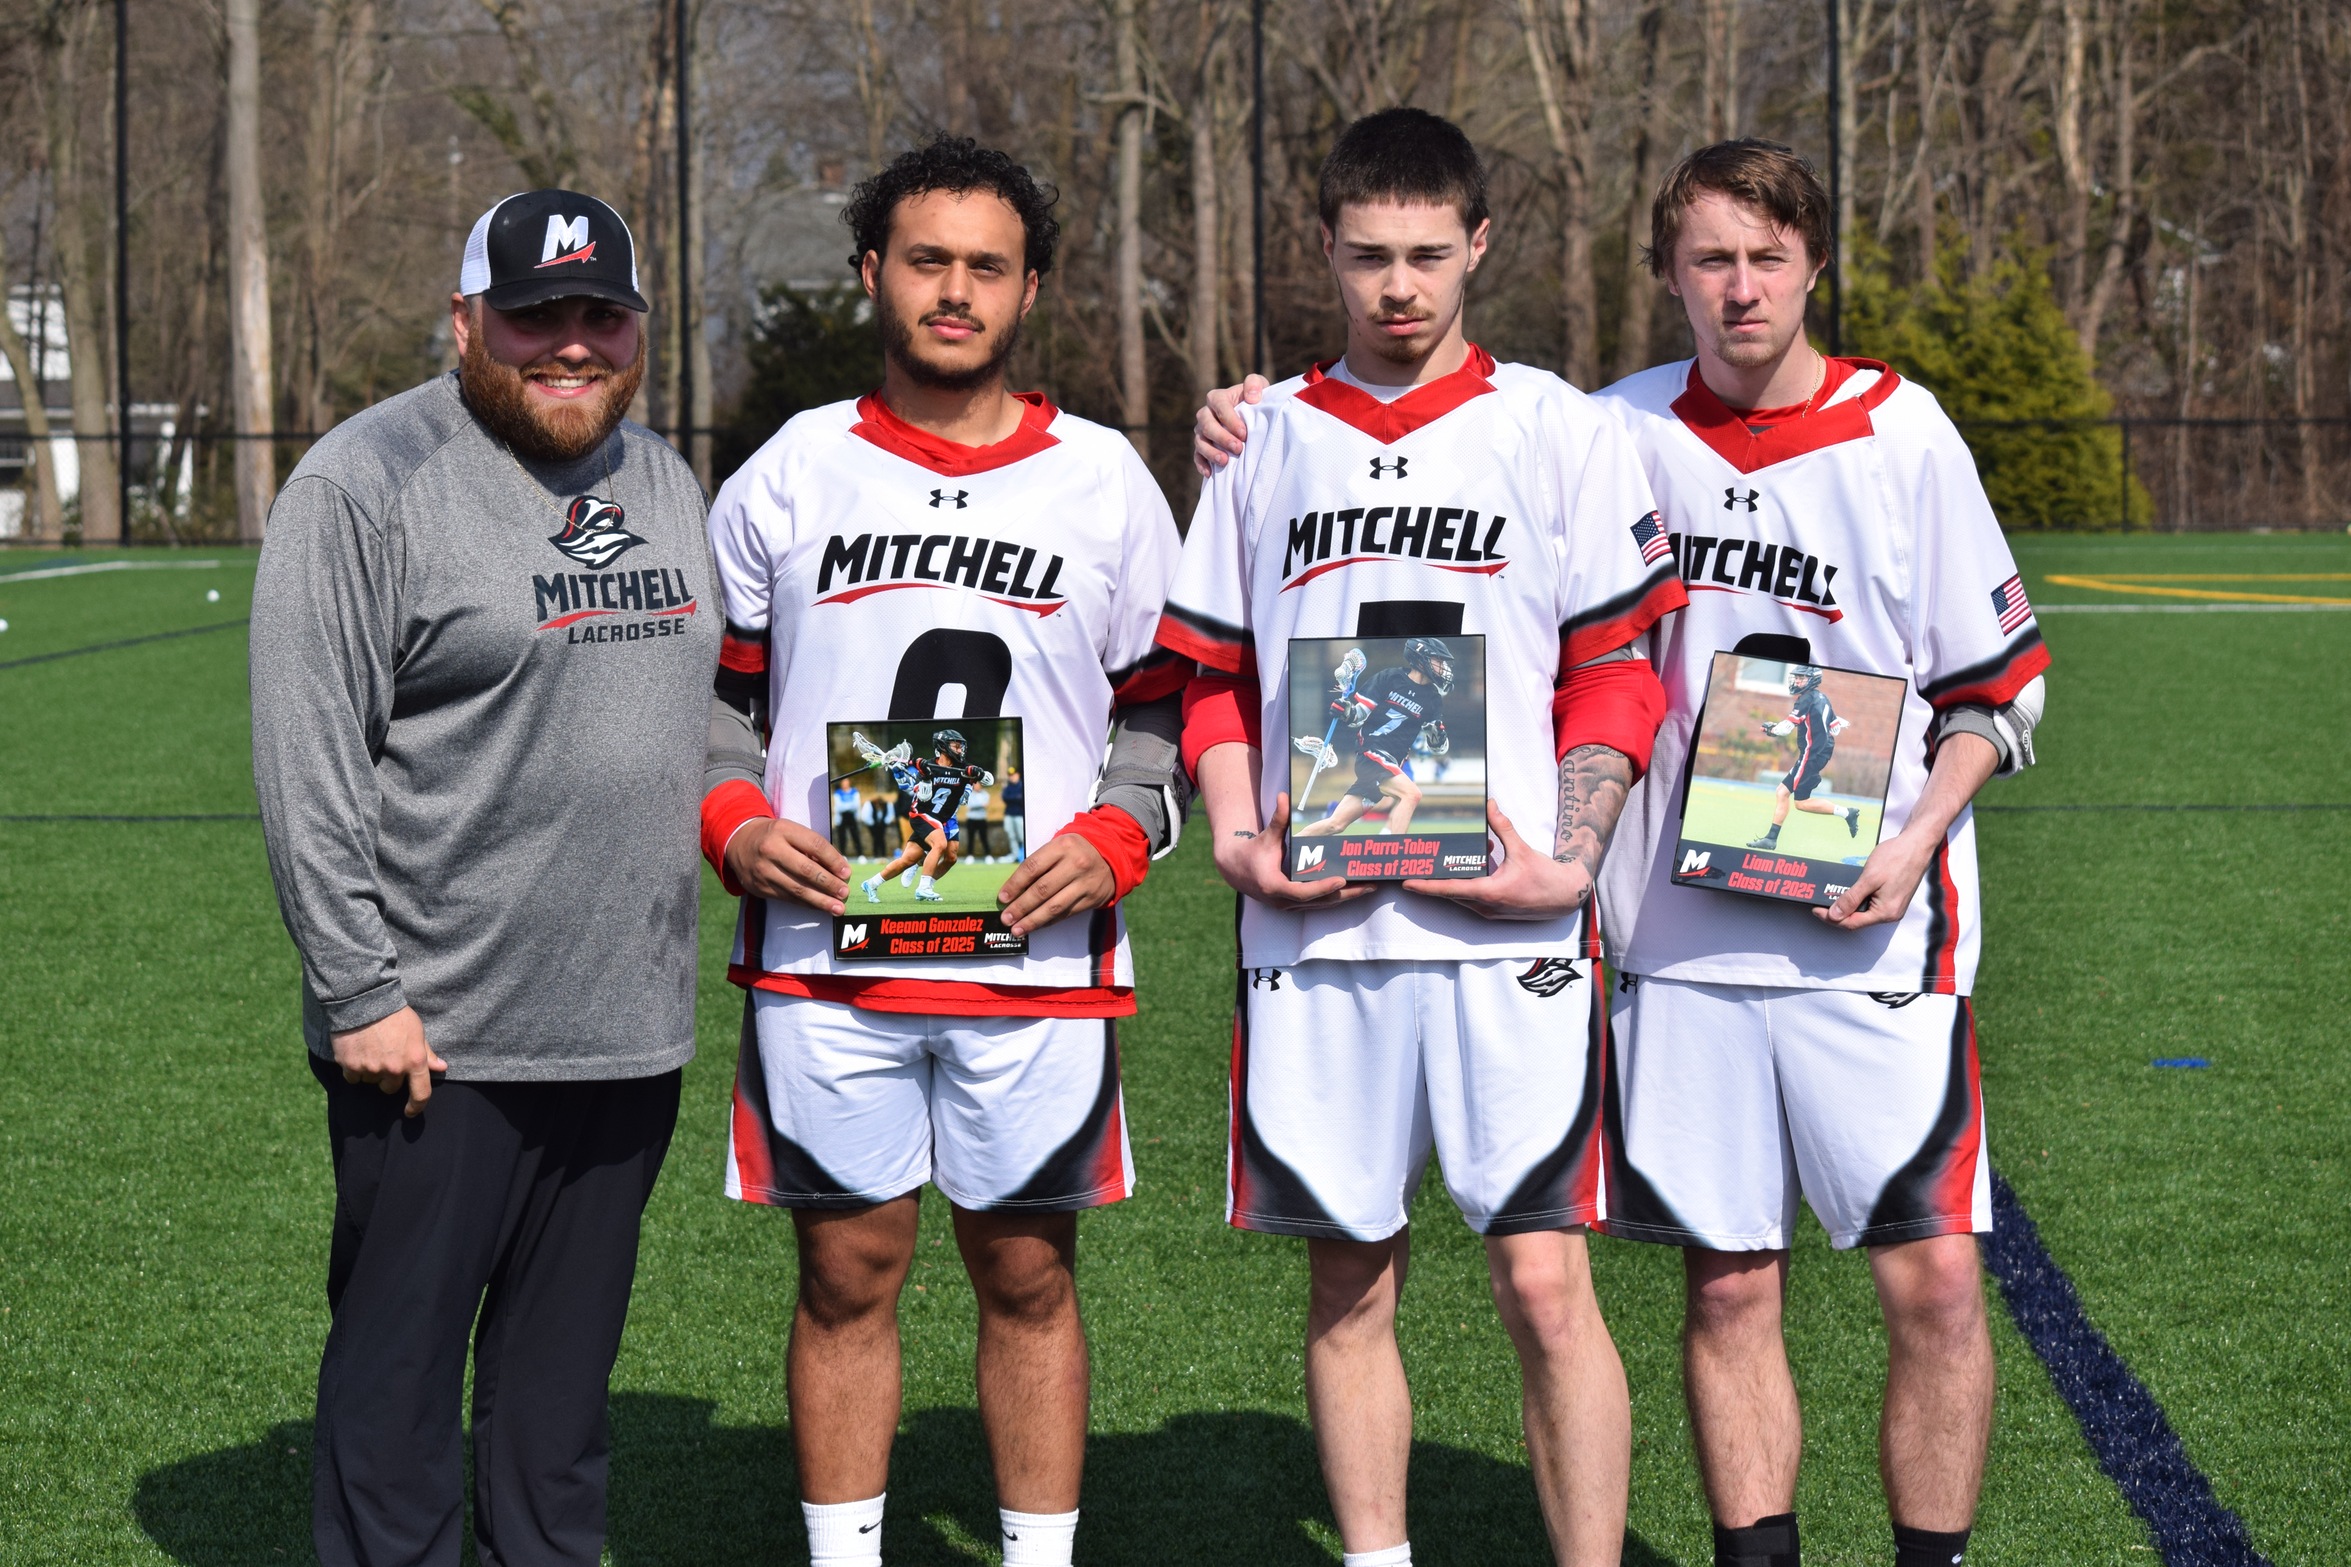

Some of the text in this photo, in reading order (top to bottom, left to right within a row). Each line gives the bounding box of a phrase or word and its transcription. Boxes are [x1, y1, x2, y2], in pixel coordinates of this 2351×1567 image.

[542, 214, 589, 263] M
[1282, 506, 1507, 581] MITCHELL
[817, 533, 1065, 599] MITCHELL
[532, 568, 695, 622] MITCHELL
[568, 618, 685, 644] LACROSSE
[1416, 642, 1424, 651] 7
[1387, 690, 1424, 714] MITCHELL
[1369, 708, 1408, 736] 7
[933, 776, 960, 786] MITCHELL
[1297, 845, 1325, 871] M
[1340, 838, 1441, 857] Jon Parra-Tobey
[1347, 858, 1434, 877] Class of 2025
[1443, 855, 1487, 866] MITCHELL
[1680, 849, 1711, 873] M
[1742, 853, 1808, 878] Liam Robb
[1727, 871, 1816, 900] Class of 2025
[840, 923, 868, 949] M
[880, 916, 984, 935] Keeano Gonzalez
[890, 936, 976, 954] Class of 2025
